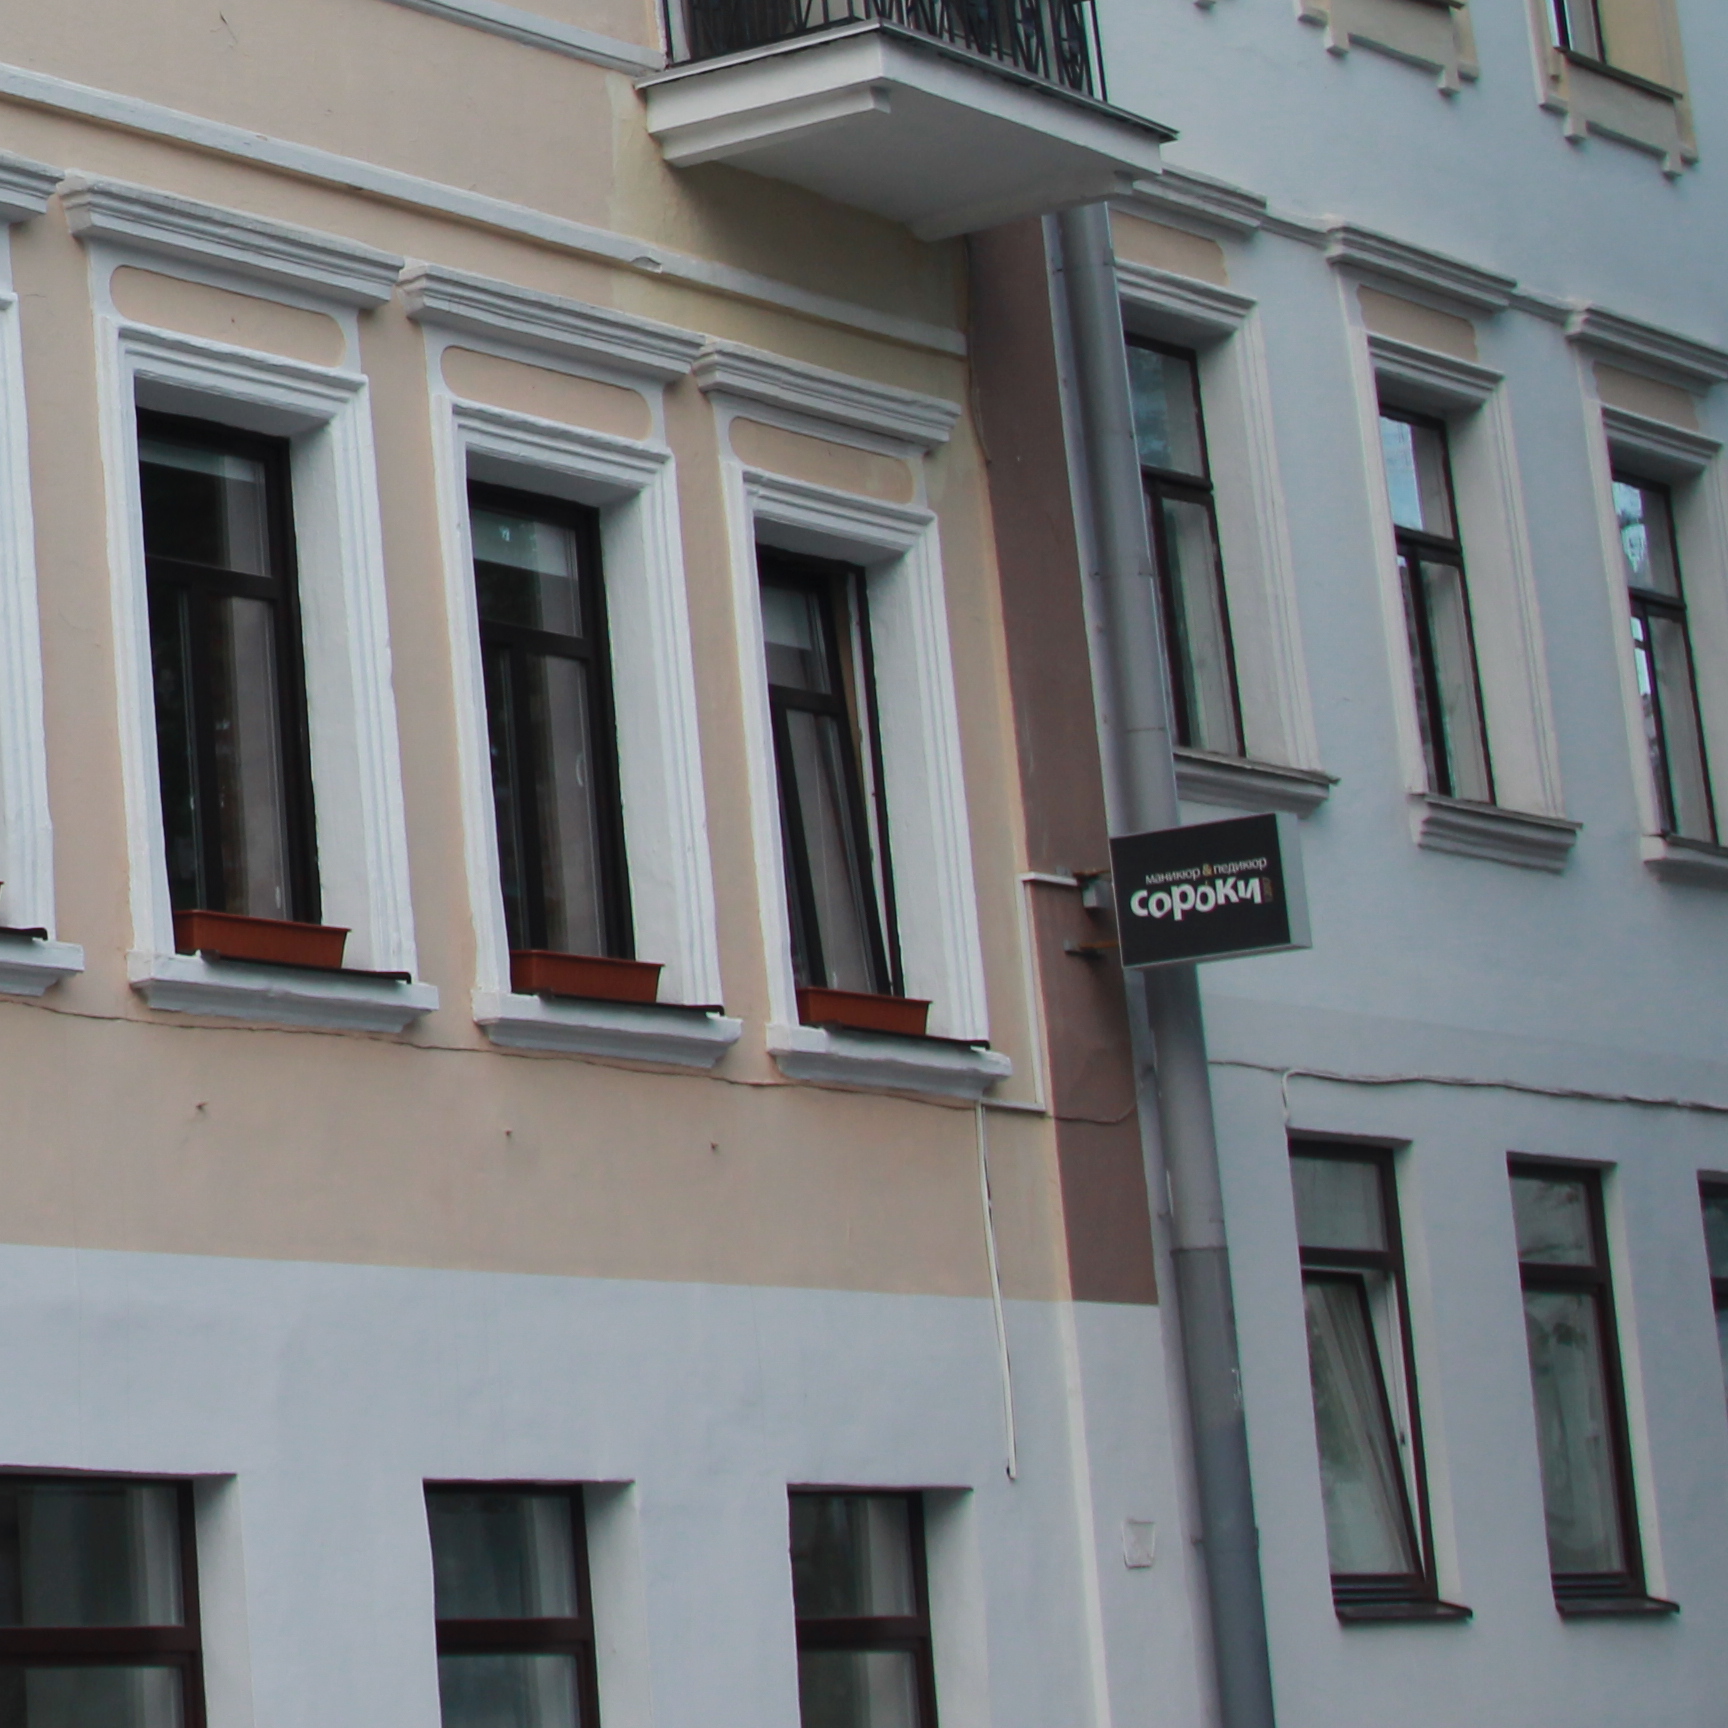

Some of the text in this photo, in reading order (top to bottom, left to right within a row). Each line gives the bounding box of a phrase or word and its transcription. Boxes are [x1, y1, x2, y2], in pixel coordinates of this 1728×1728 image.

[1145, 867, 1201, 885] маникюр
[1213, 856, 1268, 875] педикюр
[1130, 875, 1263, 921] сороки
